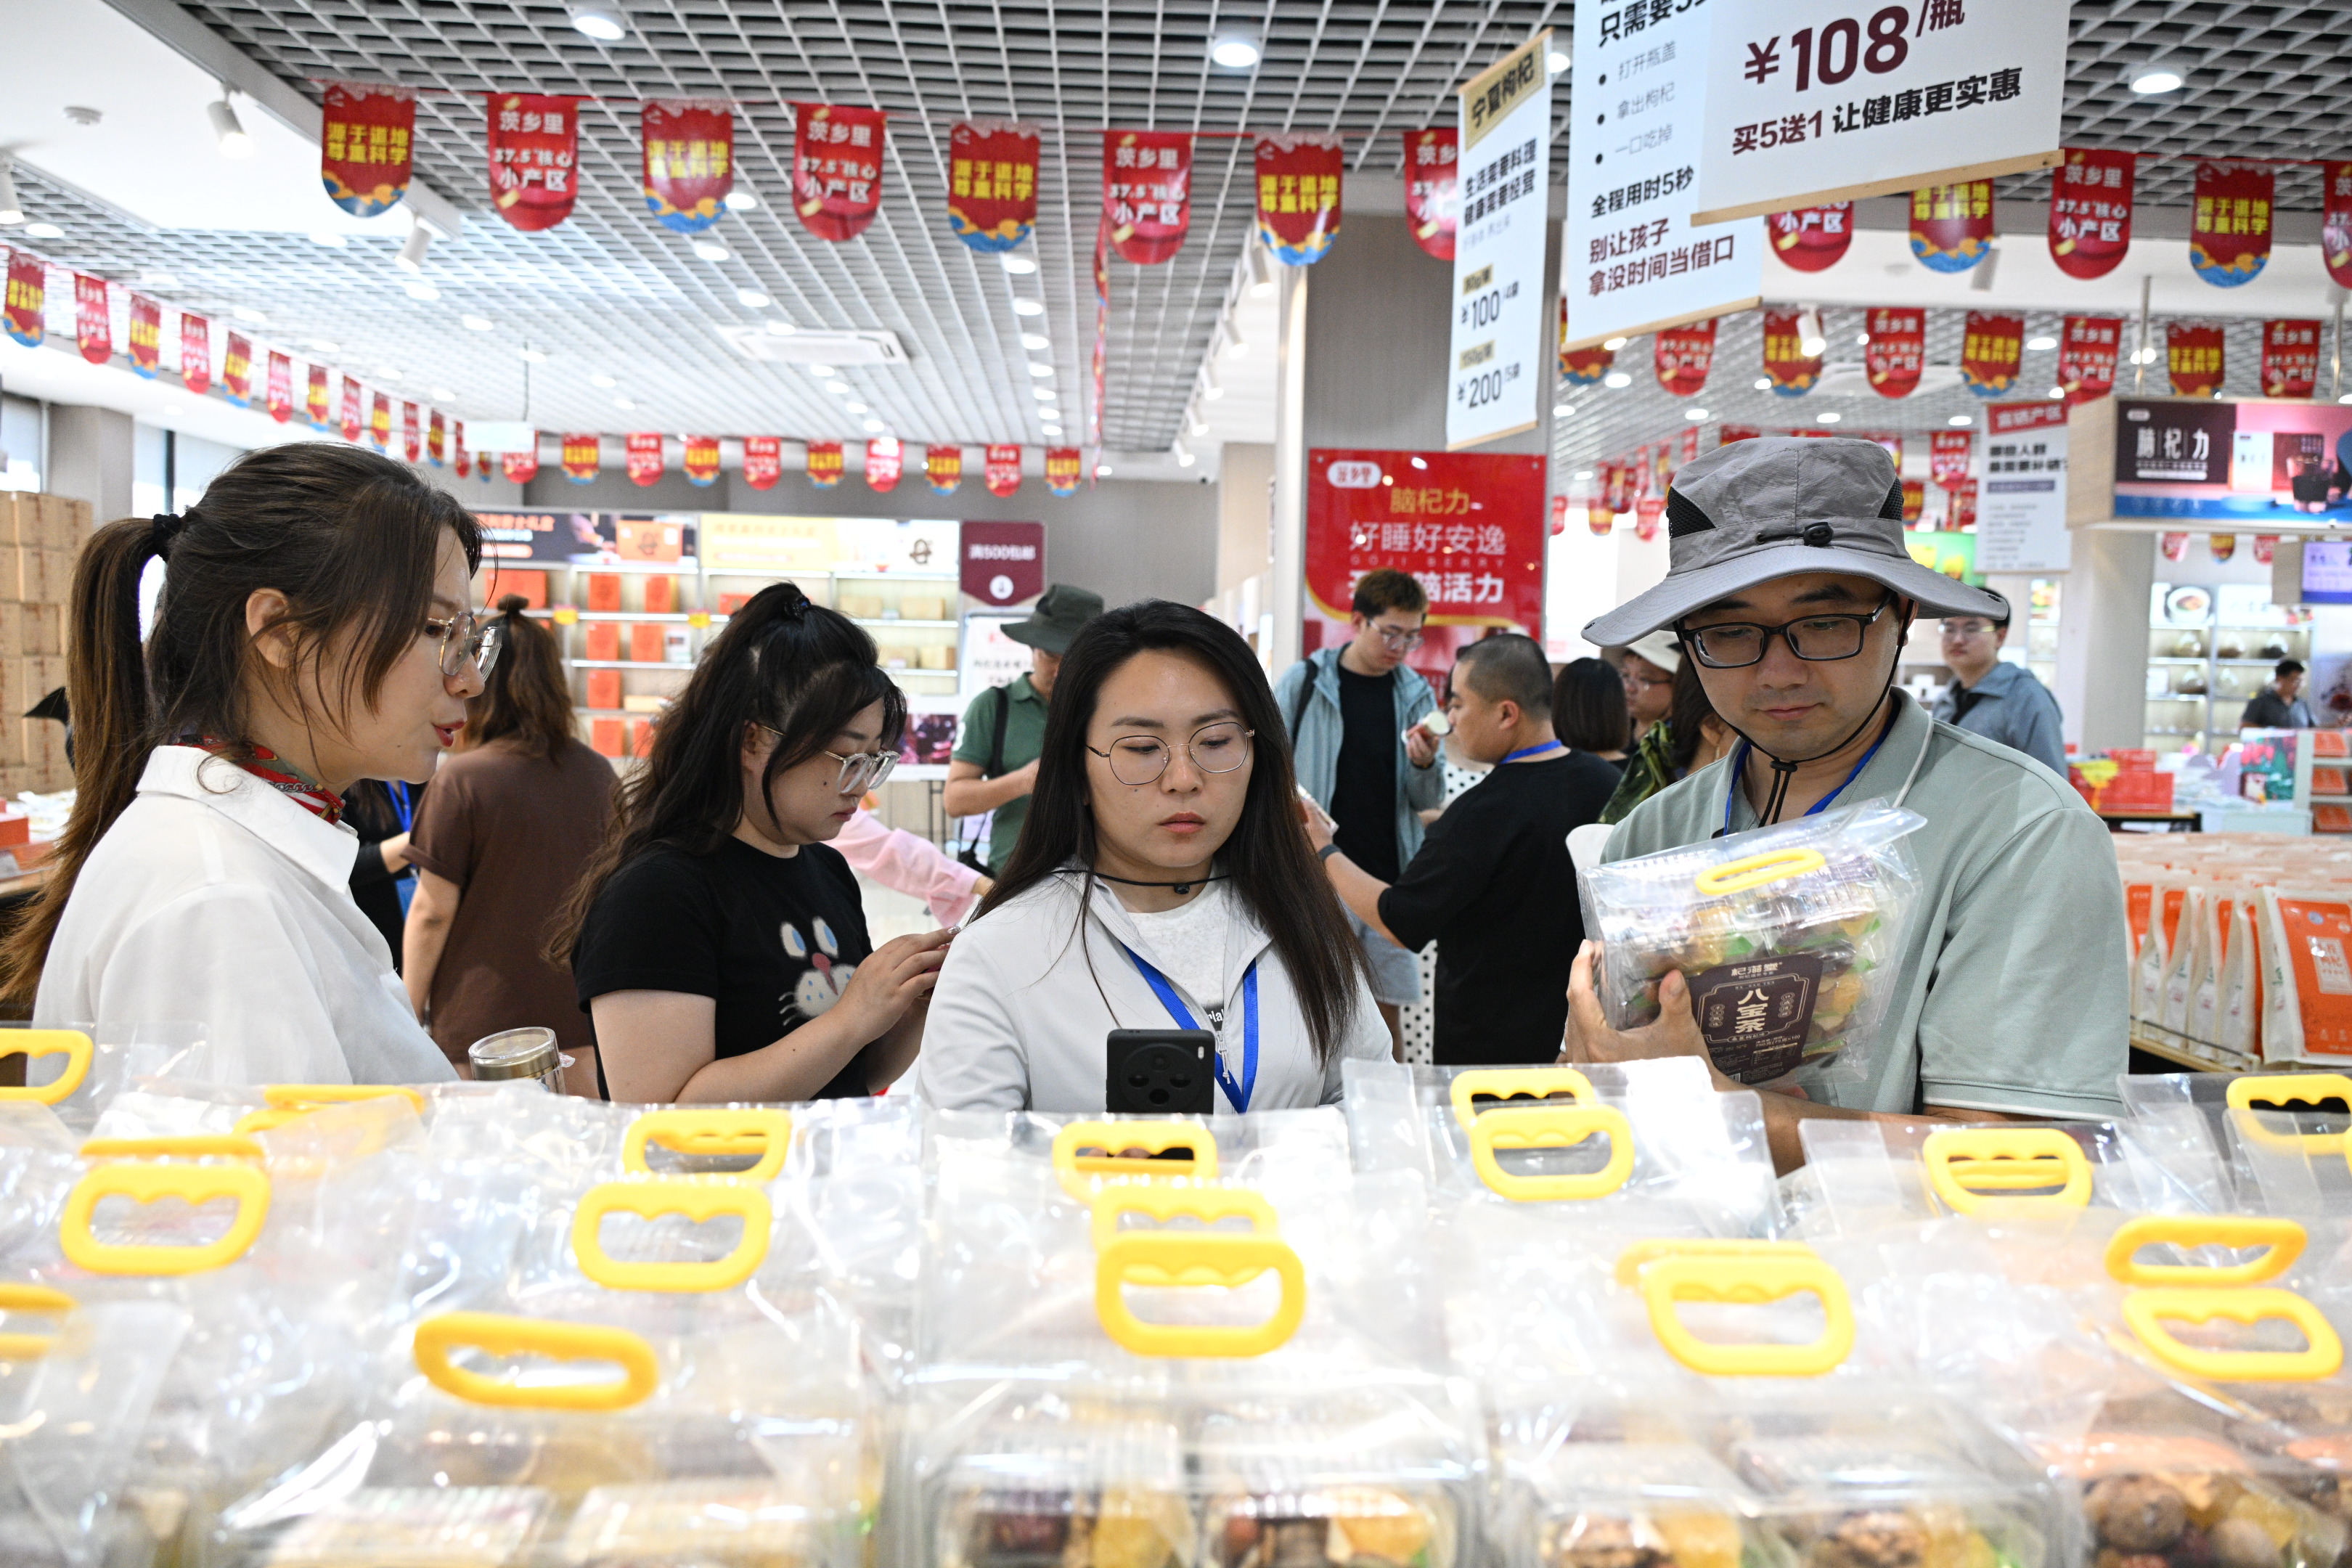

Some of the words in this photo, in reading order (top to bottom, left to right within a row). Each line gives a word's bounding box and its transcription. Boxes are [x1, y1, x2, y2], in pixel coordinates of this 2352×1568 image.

[1599, 0, 1706, 47] 只需要
[1619, 40, 1676, 81] 打开瓶盖
[1617, 81, 1675, 120] 拿出枸杞
[1732, 110, 1823, 155] 买5送1
[1833, 67, 2023, 134] 让健康更实惠
[499, 166, 568, 192] 小产区
[803, 176, 870, 203] 小产区
[1591, 165, 1694, 218] 全程用时5秒
[1114, 203, 1180, 225] 小产区
[1778, 211, 1844, 233] 小产区
[2057, 216, 2121, 242] 小产区
[1589, 218, 1669, 264] 别让孩子
[1589, 234, 1734, 297] 拿没时间当借口
[1390, 487, 1470, 515] 脑杞力
[1349, 520, 1506, 555] 好睡好安逸
[1427, 555, 1505, 568] BERRY
[1734, 988, 1769, 1033] 八宝茶
